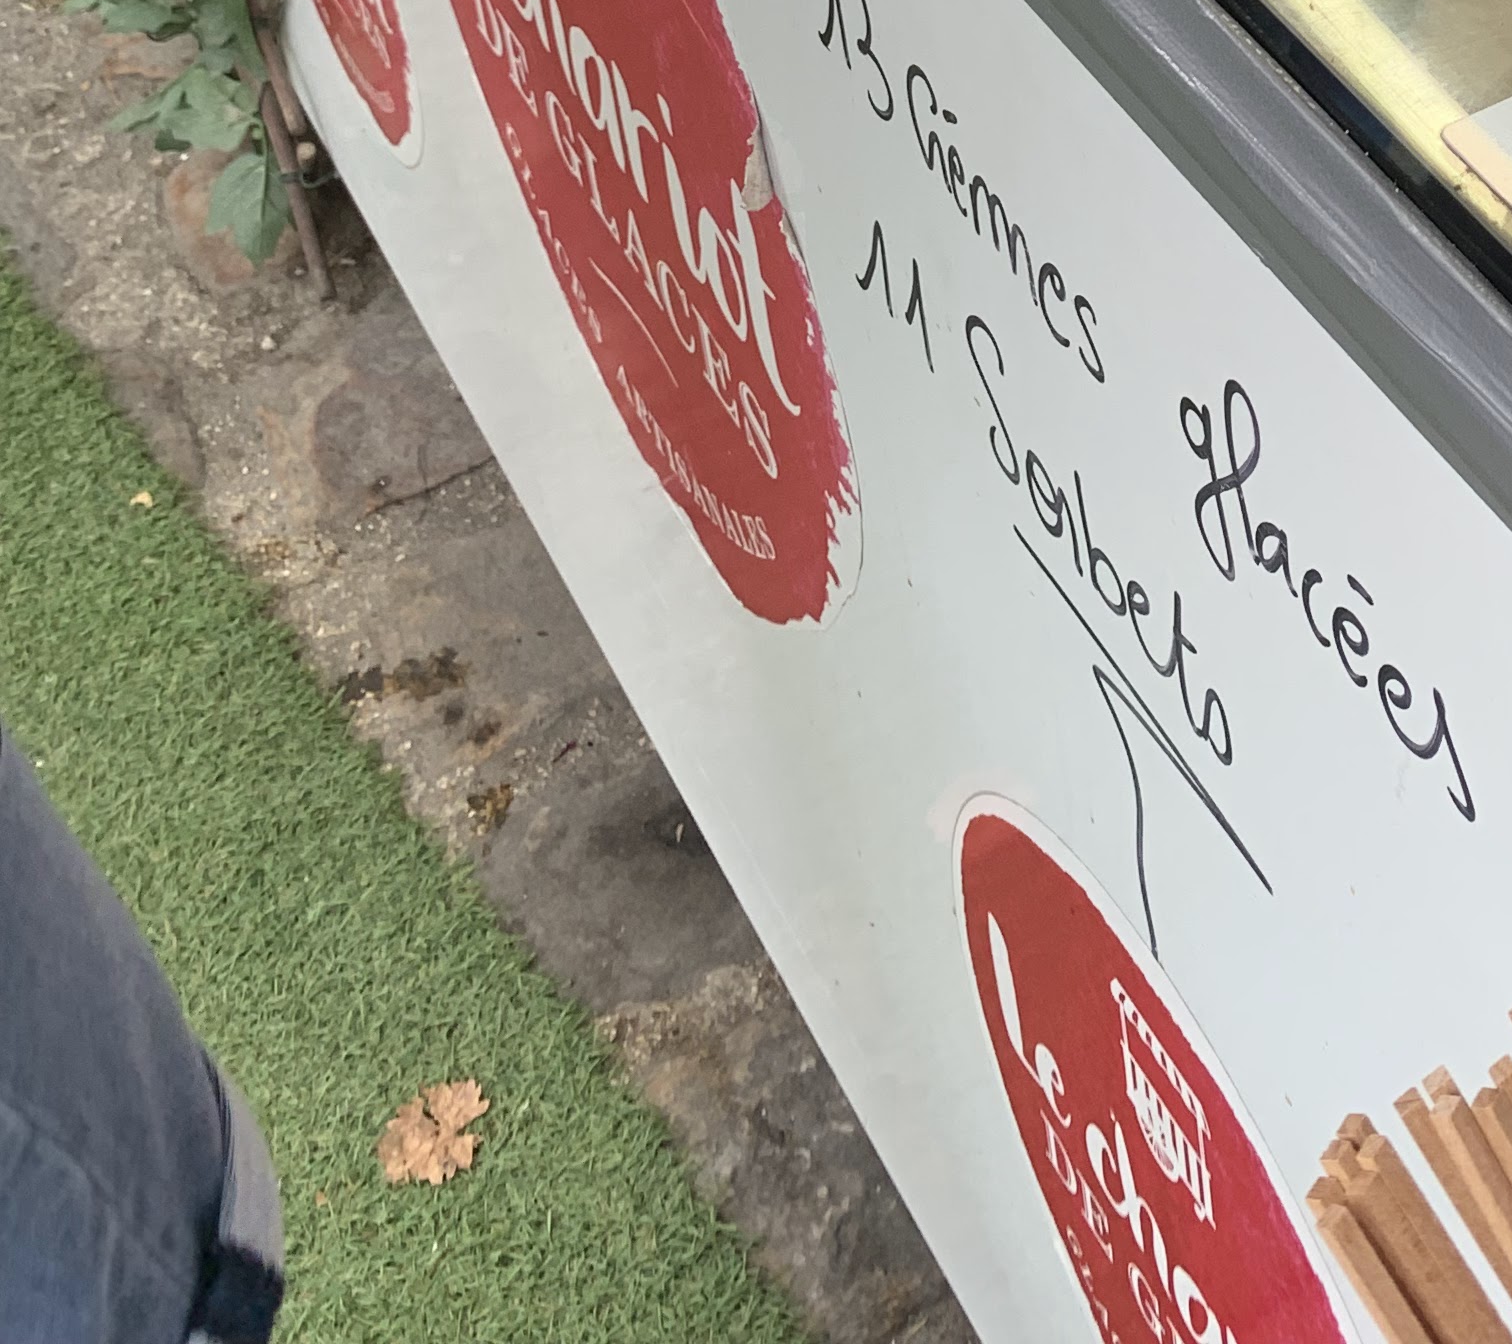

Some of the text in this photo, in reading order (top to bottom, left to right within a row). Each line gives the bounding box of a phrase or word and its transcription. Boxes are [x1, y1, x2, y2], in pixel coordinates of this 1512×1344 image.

[544, 89, 779, 480] GLACES
[857, 219, 937, 374] 11
[615, 364, 777, 562] ARTISANALES
[986, 910, 1072, 1129] Le
[1039, 1108, 1115, 1265] DE
